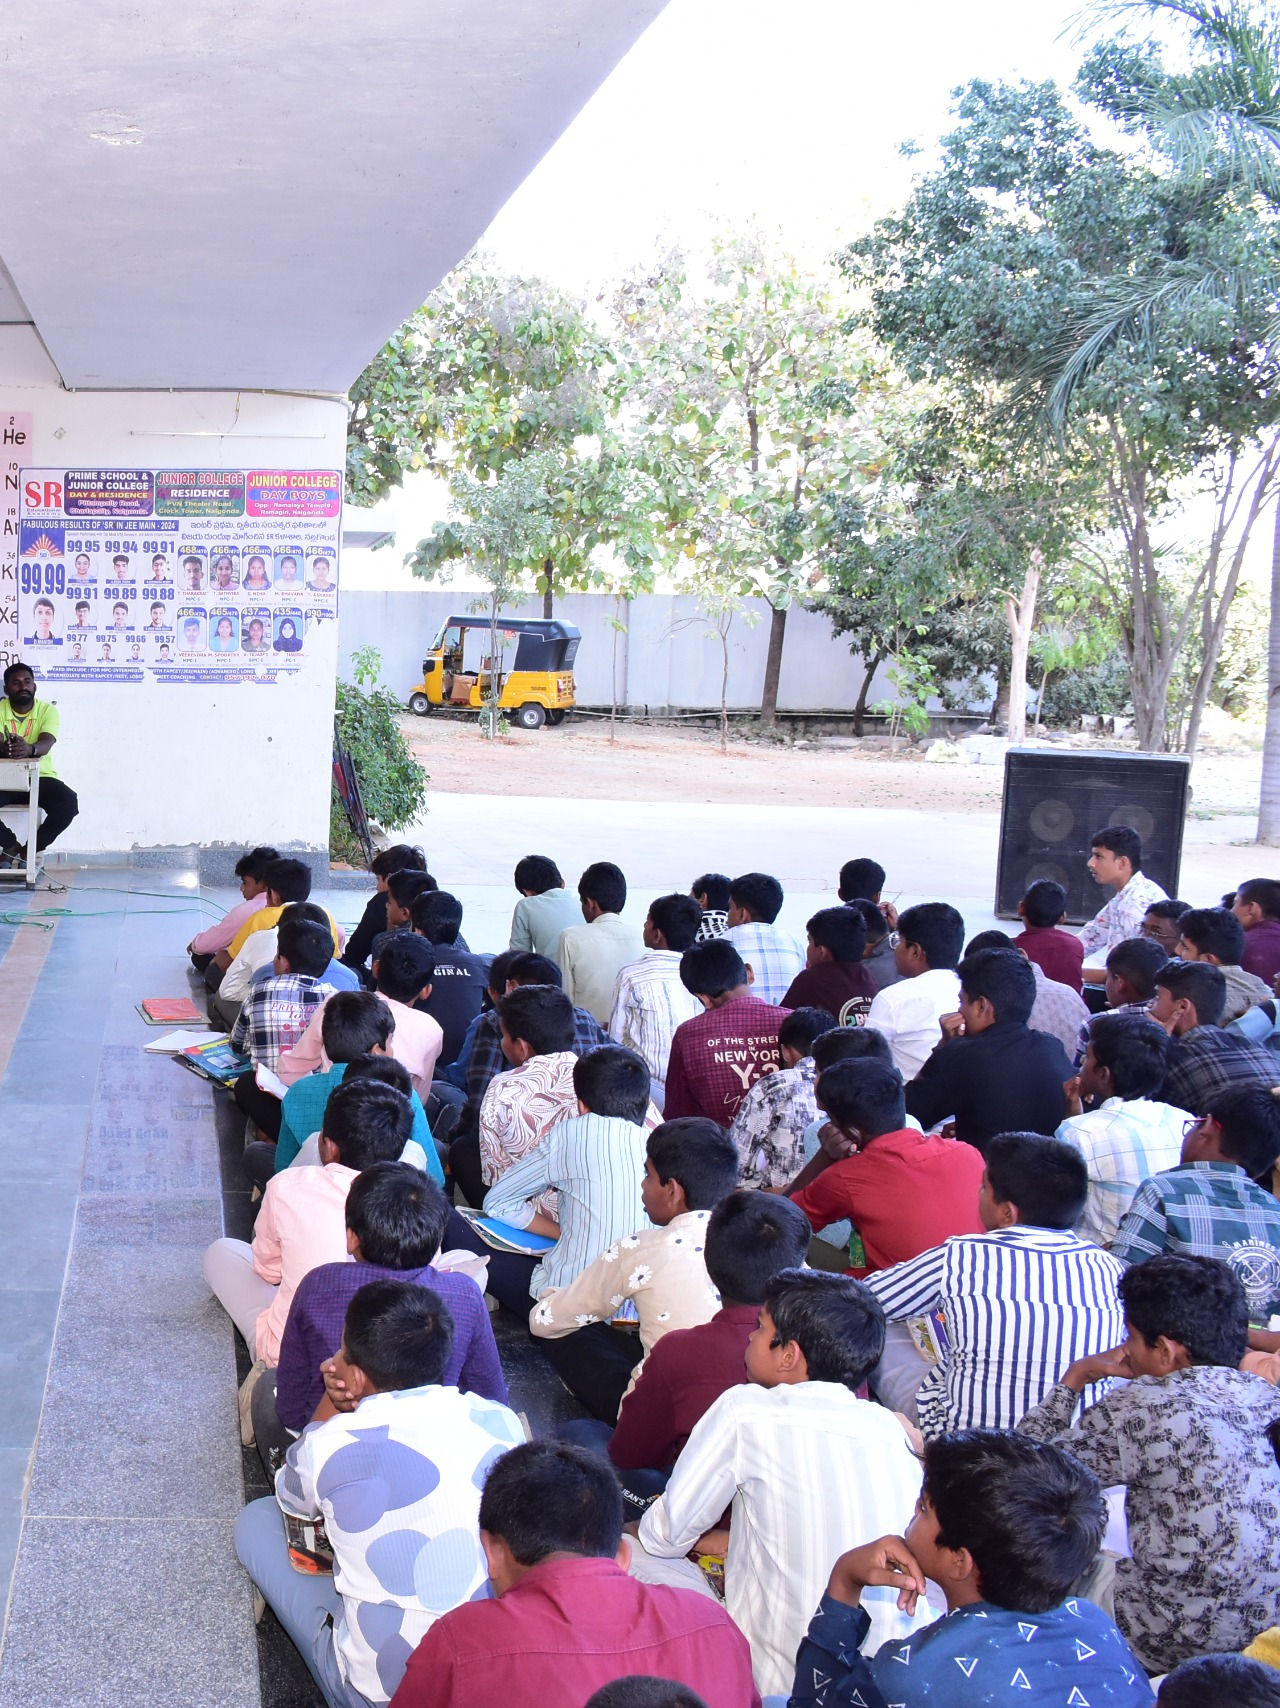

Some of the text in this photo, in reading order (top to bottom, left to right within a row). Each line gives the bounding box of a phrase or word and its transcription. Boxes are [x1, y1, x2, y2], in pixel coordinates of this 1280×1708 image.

[3, 429, 26, 445] He
[158, 473, 243, 485] JUNIOR COLLEGE
[250, 476, 337, 487] JUNIOR COLLEGE
[68, 482, 102, 490] JUNIOR
[25, 481, 62, 508] SR
[171, 489, 230, 498] RESIDENCE
[261, 491, 286, 499] DAY
[67, 541, 175, 553] 99.95 99.94 99.91
[21, 563, 65, 594] 99.99
[66, 587, 98, 599] 99.91
[104, 588, 137, 600] 99.89
[142, 588, 175, 600] 99.88
[67, 634, 87, 642] 99.77
[126, 635, 146, 643] 99.66
[714, 1050, 747, 1063] NEW
